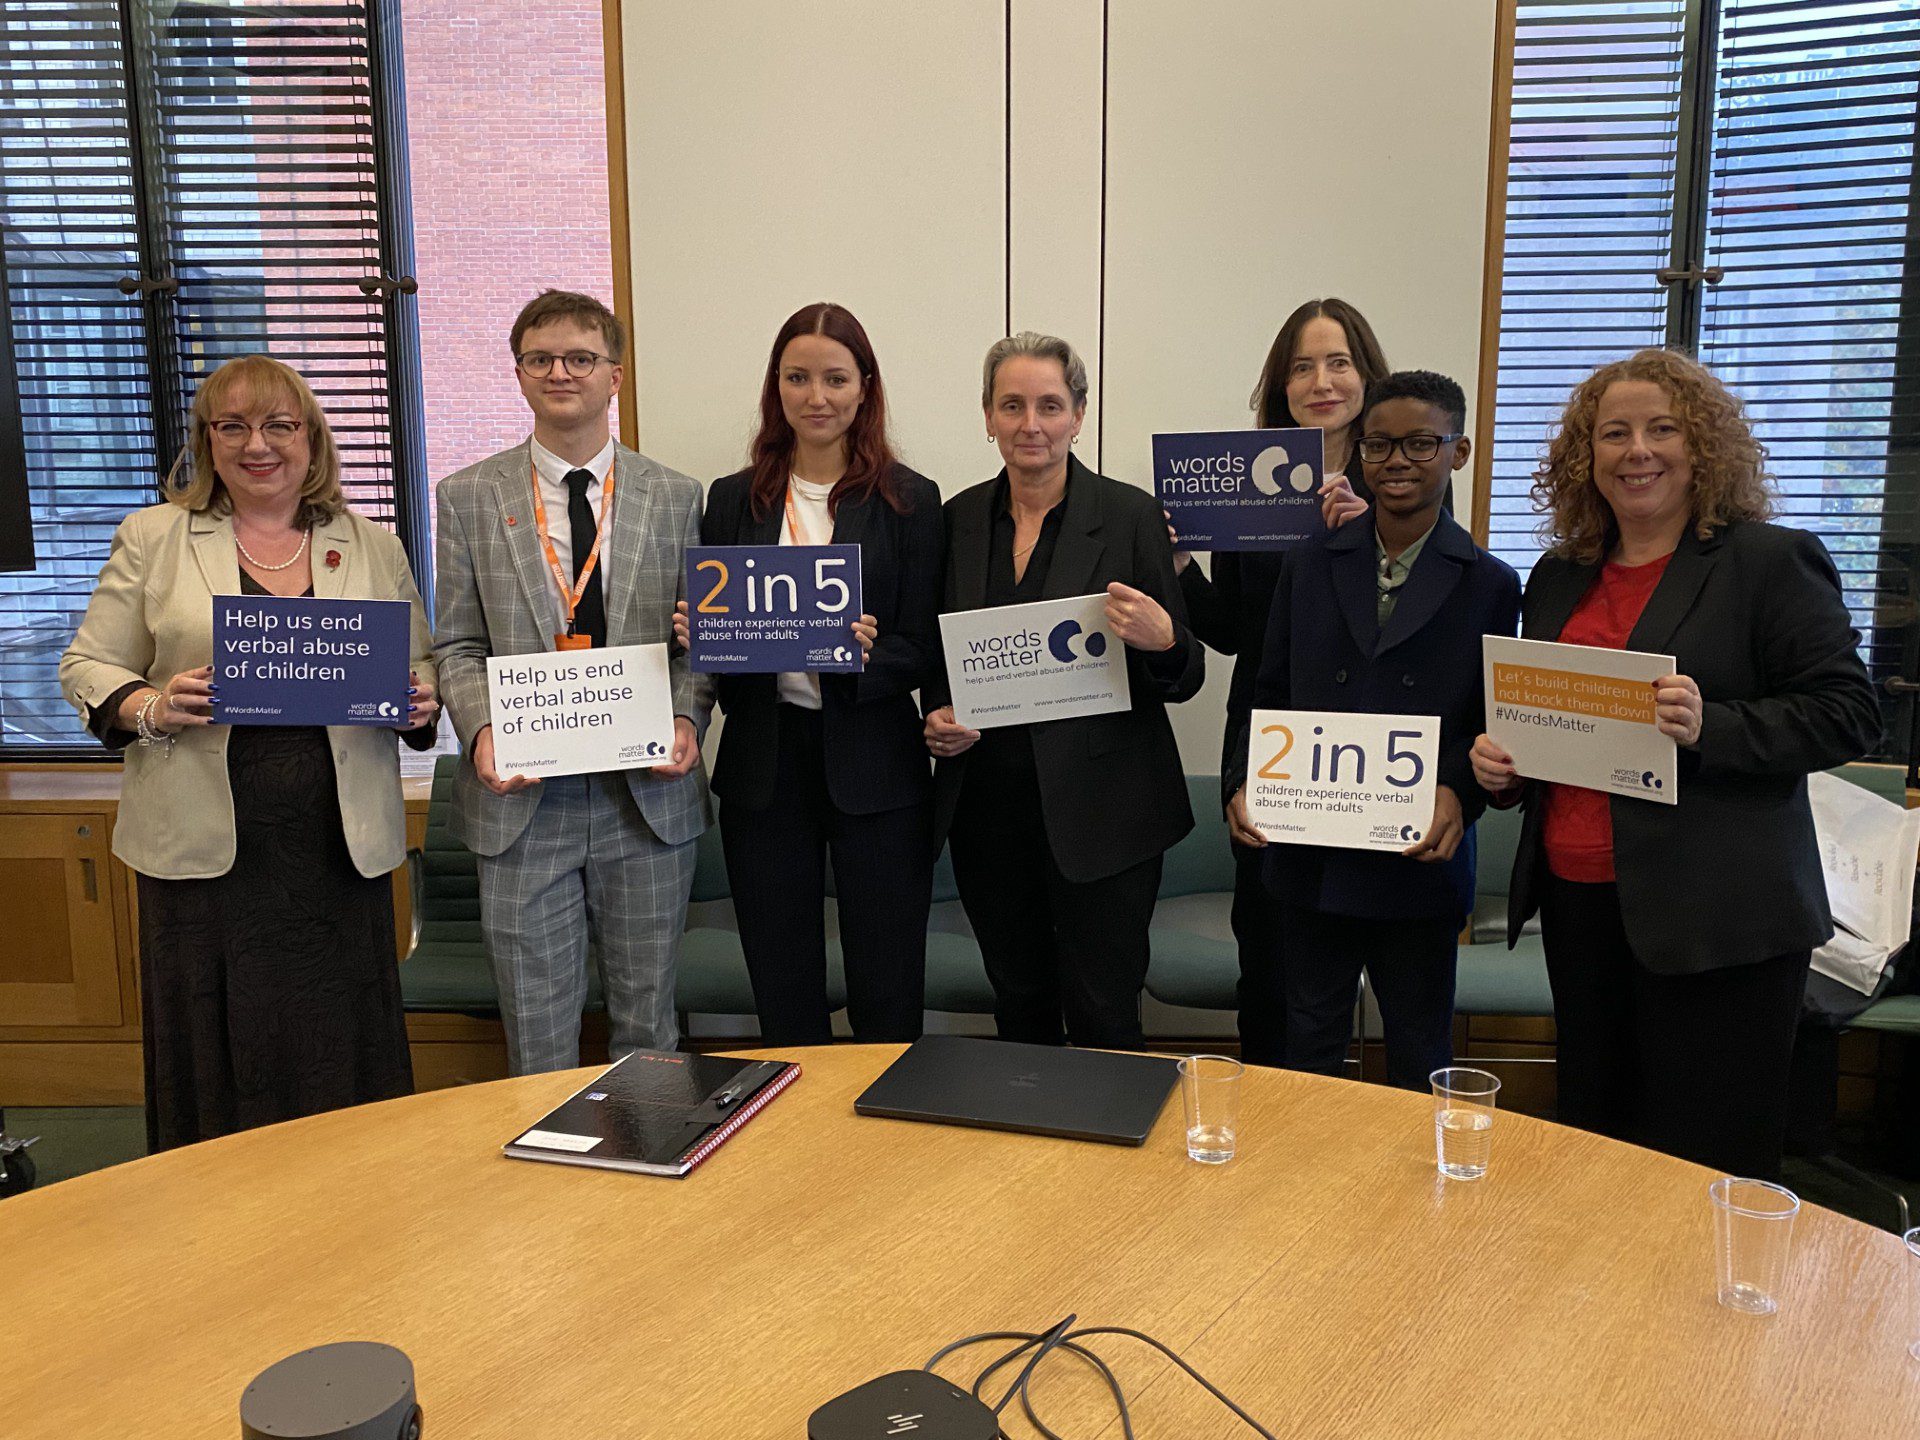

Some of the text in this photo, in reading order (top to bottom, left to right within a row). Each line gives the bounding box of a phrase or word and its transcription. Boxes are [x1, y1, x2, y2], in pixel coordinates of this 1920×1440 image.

[1170, 451, 1245, 474] words
[1162, 473, 1245, 494] matter
[1163, 499, 1182, 508] help
[1194, 499, 1211, 507] end
[1211, 498, 1239, 506] verbal
[1240, 498, 1266, 506] abuse
[1267, 497, 1277, 505] of
[1278, 497, 1314, 506] children
[696, 558, 850, 613] 2 in 5
[225, 609, 363, 631] Help us end
[698, 617, 843, 629] children experience verbal
[698, 629, 800, 641] abuse from adults
[968, 628, 1042, 654] words
[224, 636, 370, 656] verbal abuse
[809, 647, 833, 655] words
[699, 654, 749, 662] #WordsMatter
[962, 649, 1043, 673] matter
[225, 660, 346, 681] of children
[499, 659, 624, 686] Help us end
[965, 660, 1109, 685] help us end verbal abuse of children
[1498, 668, 1531, 684] Let's
[1536, 674, 1569, 691] build
[1573, 679, 1630, 699] children
[500, 686, 633, 710] verbal abuse
[970, 691, 1113, 714] #WordsMatter www.wordsmatter.org
[1499, 689, 1650, 720] not knock them down
[224, 706, 282, 715] #WordsMatter
[347, 708, 377, 716] matter
[1495, 706, 1597, 733] #WordsMatter
[503, 711, 613, 735] of children
[618, 749, 645, 758] matter
[621, 743, 645, 752] words
[1257, 724, 1424, 788] 2 in 5
[505, 758, 558, 769] #WordsMatter
[1613, 767, 1640, 778] words
[1610, 773, 1640, 785] matter
[1256, 784, 1414, 804] children experience verbal
[1255, 797, 1364, 814] abuse from adults
[1254, 821, 1306, 832] #WordsMatter
[1369, 831, 1398, 839] matter
[1372, 824, 1399, 833] words
